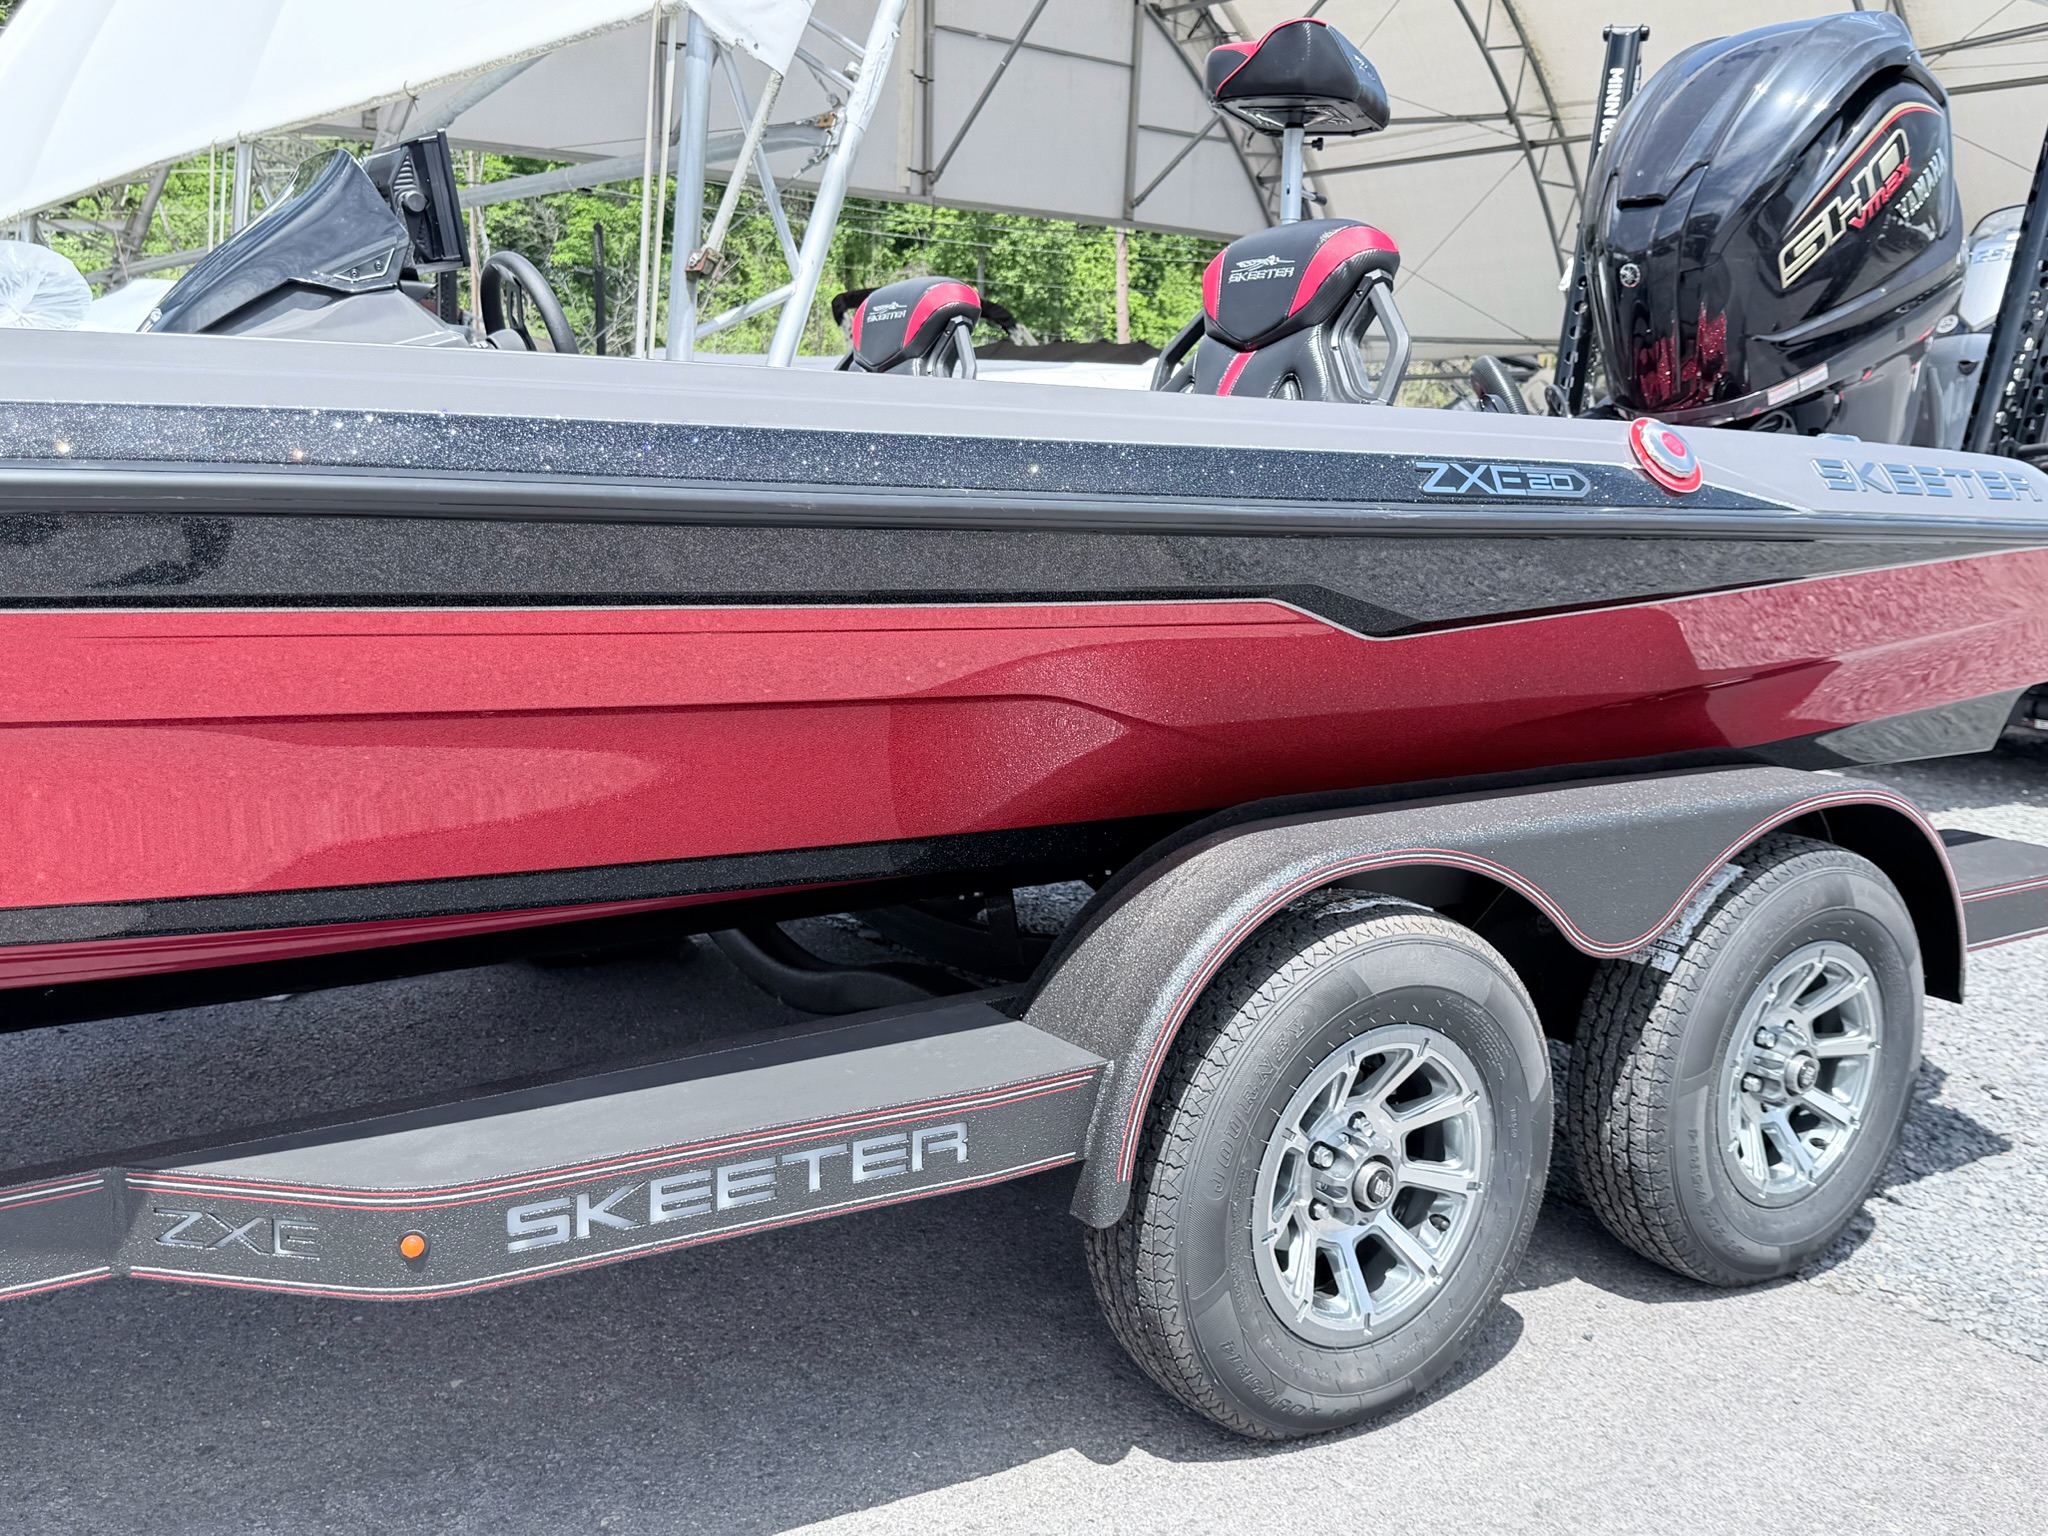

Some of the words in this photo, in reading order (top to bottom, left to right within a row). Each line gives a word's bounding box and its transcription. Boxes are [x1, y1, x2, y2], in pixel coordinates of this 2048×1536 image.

[1604, 67, 1625, 116] MINN
[1597, 118, 1618, 151] KO
[1895, 148, 1948, 219] YAMAHA
[1228, 266, 1295, 284] SKEETER
[1810, 459, 2044, 502] SKEETER
[1211, 1010, 1305, 1193] JOURNEY
[506, 1121, 970, 1254] SKEETER
[153, 1206, 320, 1261] ZXE
